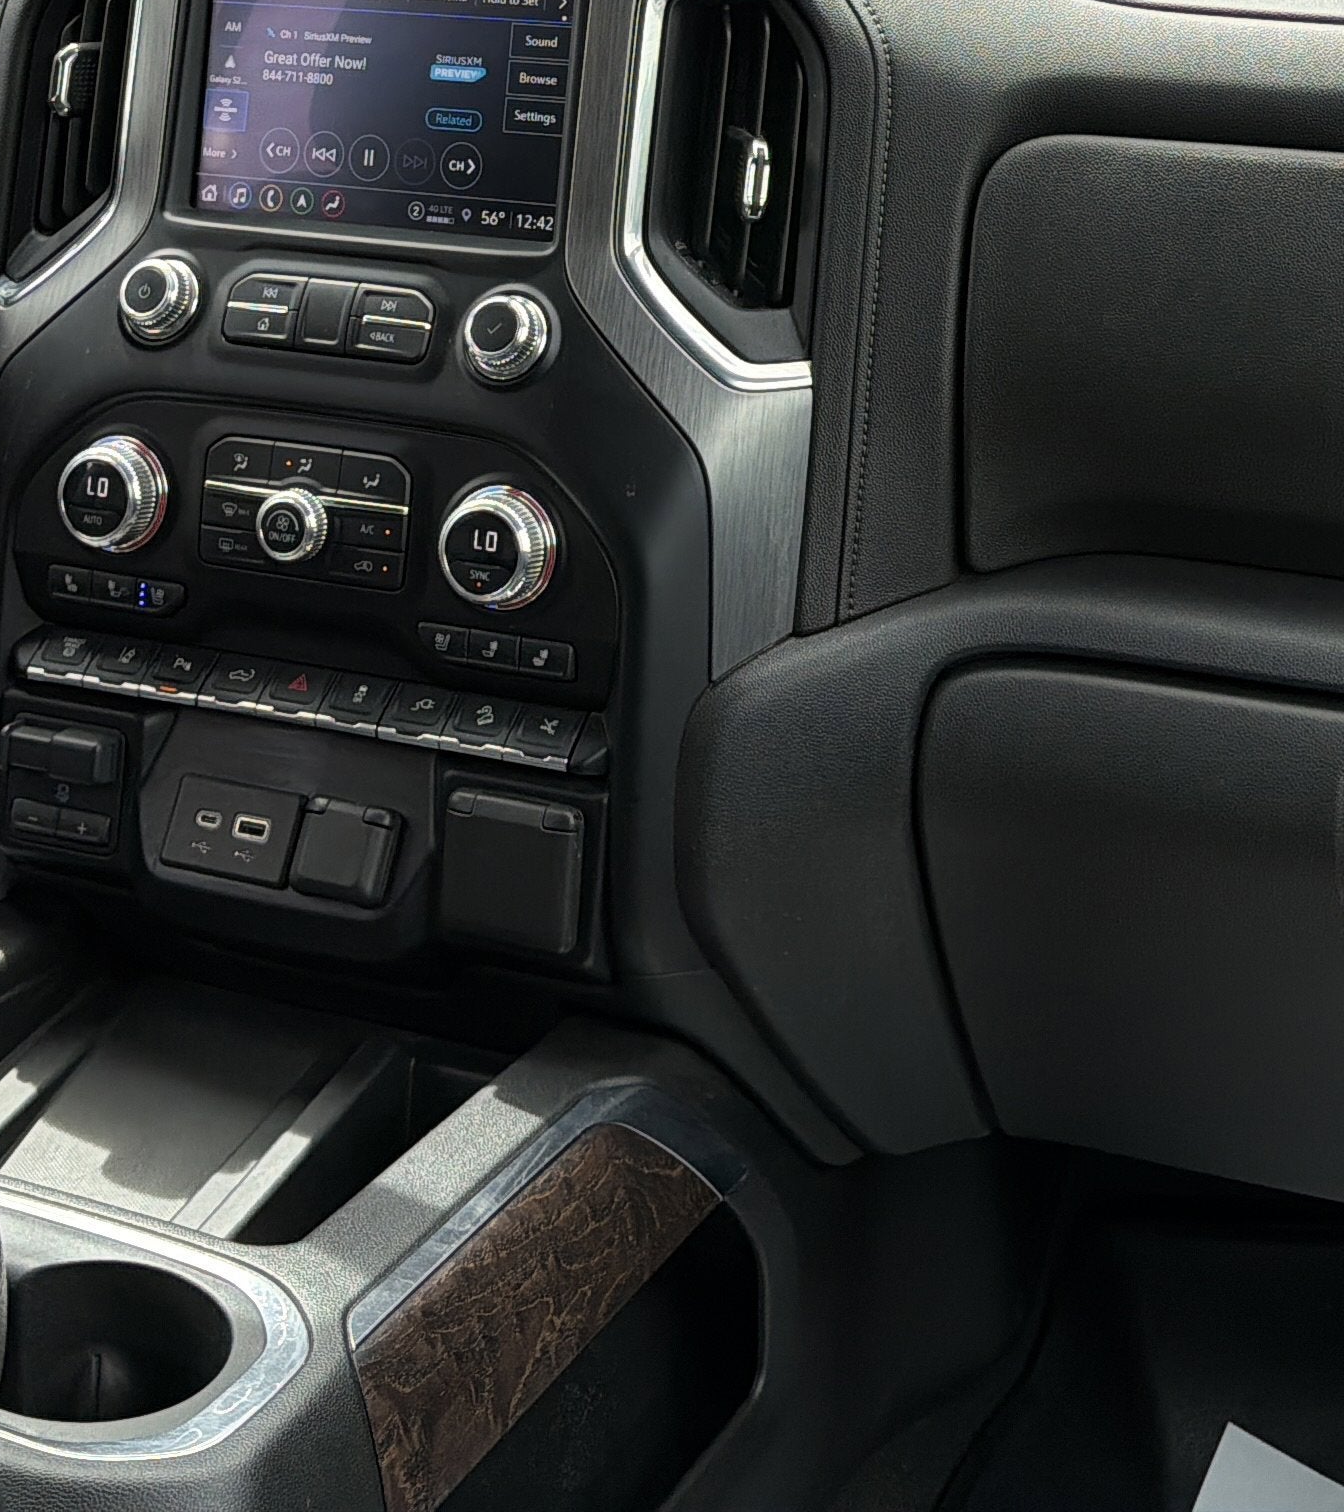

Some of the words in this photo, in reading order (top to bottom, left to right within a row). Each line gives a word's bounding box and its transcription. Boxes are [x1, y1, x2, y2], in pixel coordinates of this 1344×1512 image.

[224, 21, 242, 32] AM
[280, 30, 291, 39] Ch
[304, 31, 339, 43] SiriusXM
[341, 33, 372, 45] Preview
[525, 34, 558, 48] Sound
[264, 50, 297, 66] Great
[300, 52, 332, 68] Offer
[334, 55, 367, 71] Now!
[436, 54, 483, 67] SIRIUSXM
[262, 69, 334, 86] 844-711-8800
[519, 72, 558, 86] Browse
[436, 113, 472, 127] Related
[514, 109, 557, 127] Settings
[203, 147, 226, 159] More
[276, 145, 291, 157] CH
[449, 160, 465, 172] CH
[440, 205, 454, 214] LTE
[516, 213, 555, 232] 12:42
[376, 331, 395, 344] BACK
[86, 475, 109, 498] LO
[83, 514, 103, 526] AUTO
[268, 529, 296, 544] ON/OFF
[360, 524, 375, 536] A/C
[473, 528, 498, 553] LO
[469, 569, 491, 582] SYNC
